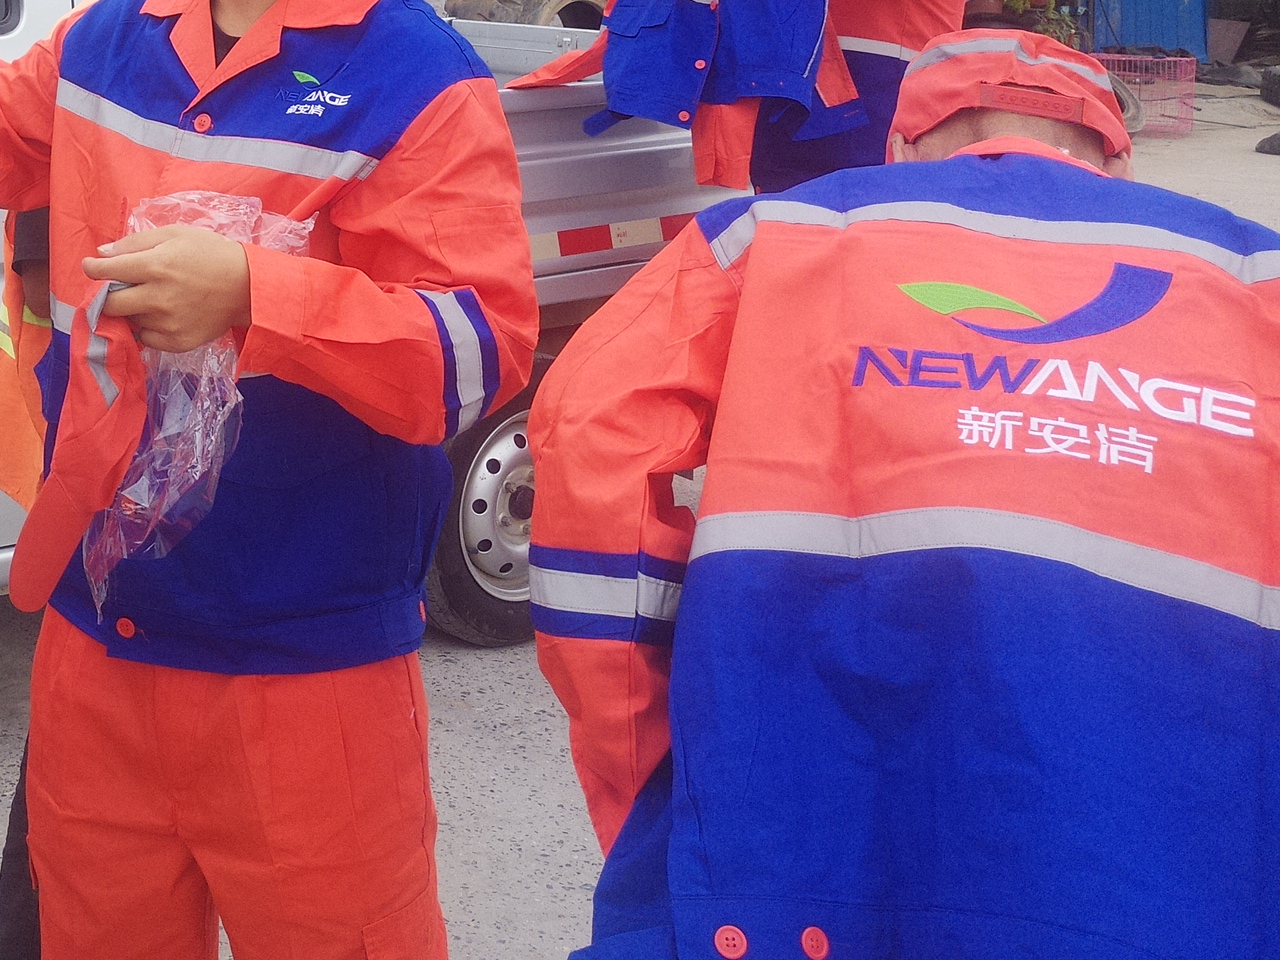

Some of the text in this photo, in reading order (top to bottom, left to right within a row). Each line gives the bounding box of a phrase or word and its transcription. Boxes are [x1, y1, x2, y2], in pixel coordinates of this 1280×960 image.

[851, 345, 1257, 437] NEWANGE
[956, 405, 1159, 474] 新安洁
